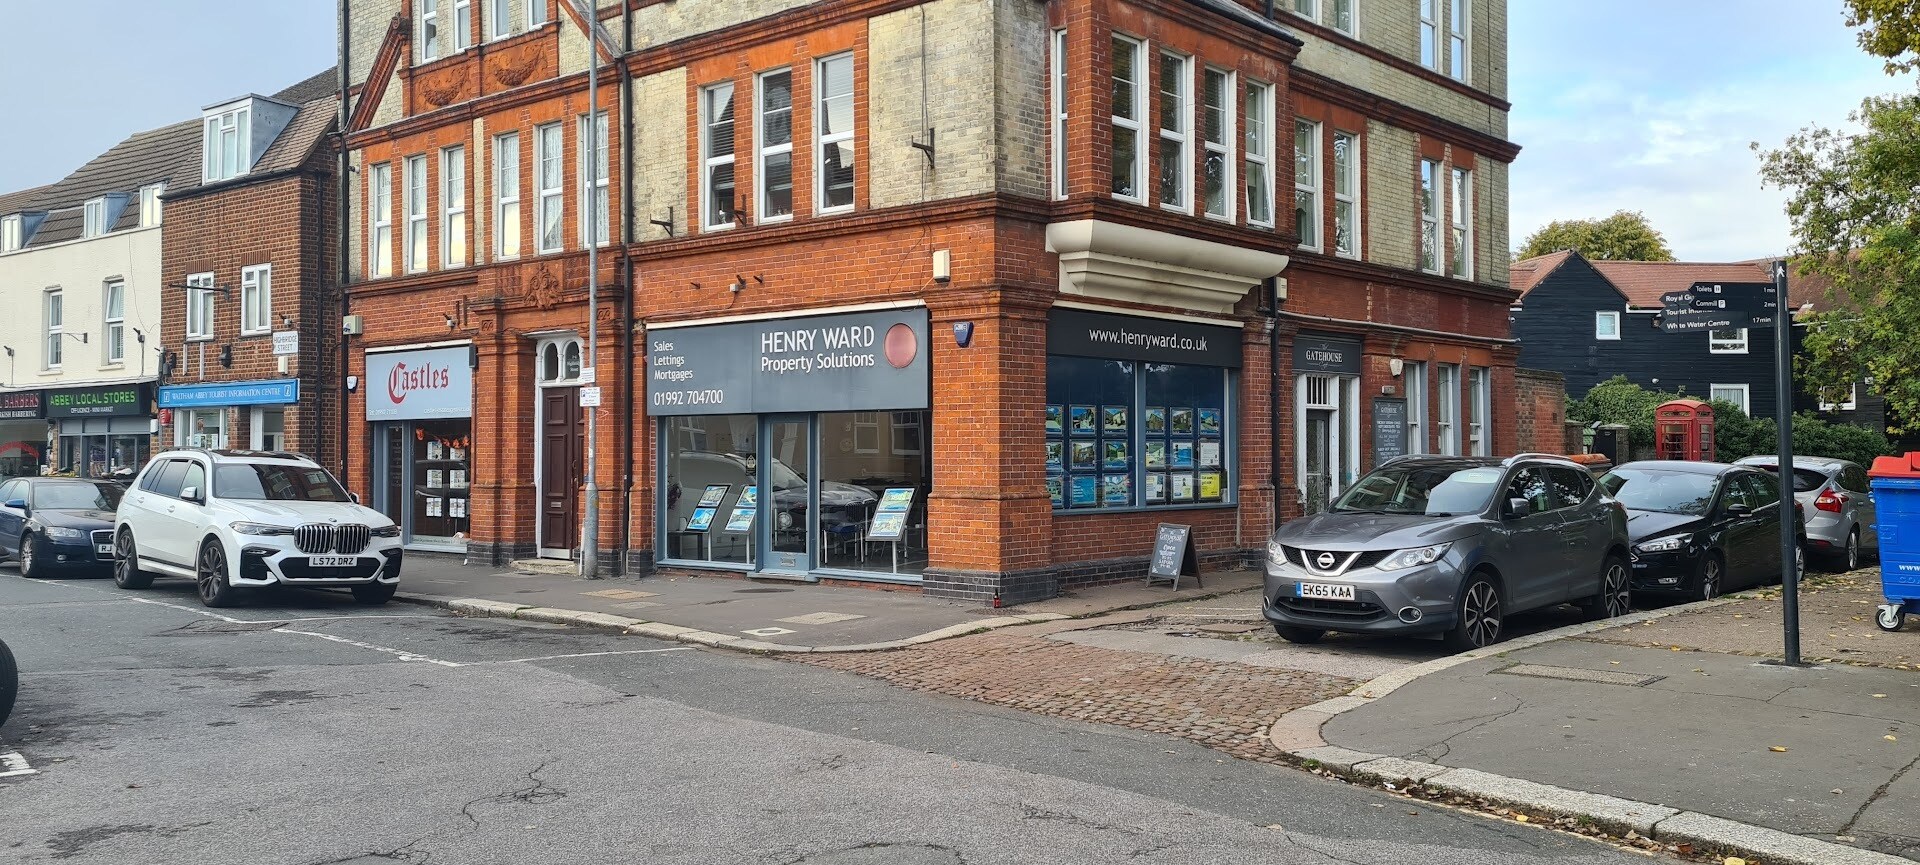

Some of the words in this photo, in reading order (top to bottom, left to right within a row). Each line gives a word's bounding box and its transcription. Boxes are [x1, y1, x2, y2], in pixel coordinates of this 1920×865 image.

[1665, 295, 1684, 303] Royal
[1708, 320, 1730, 328] Centre
[653, 340, 674, 352] Sales
[760, 328, 818, 354] HENRY
[822, 325, 875, 350] WARD
[1089, 327, 1208, 352] www.henryward.co.uk
[277, 344, 293, 352] STREET
[653, 354, 685, 368] Lettings
[760, 354, 814, 375] Property
[816, 351, 875, 370] Solutions
[1305, 350, 1343, 363] GATEHOUSE
[653, 368, 694, 382] Mortgages
[387, 361, 449, 405] Castles
[4, 392, 39, 409] BARBERS
[50, 394, 75, 406] ABBEY
[75, 392, 102, 405] LOCAL
[103, 391, 136, 404] STORES
[172, 391, 194, 401] WALTHAM
[195, 391, 208, 400] ABBEY
[209, 389, 228, 399] TOURIST
[228, 388, 261, 398] INFORMATION
[261, 387, 281, 396] CENTRE
[653, 391, 684, 407] 01992
[686, 389, 724, 405] 704700
[12, 410, 37, 418] BARBERING
[312, 557, 336, 566] LS72
[337, 557, 354, 565] DRZ
[1302, 584, 1329, 597] EK65
[1331, 586, 1352, 598] KAA
